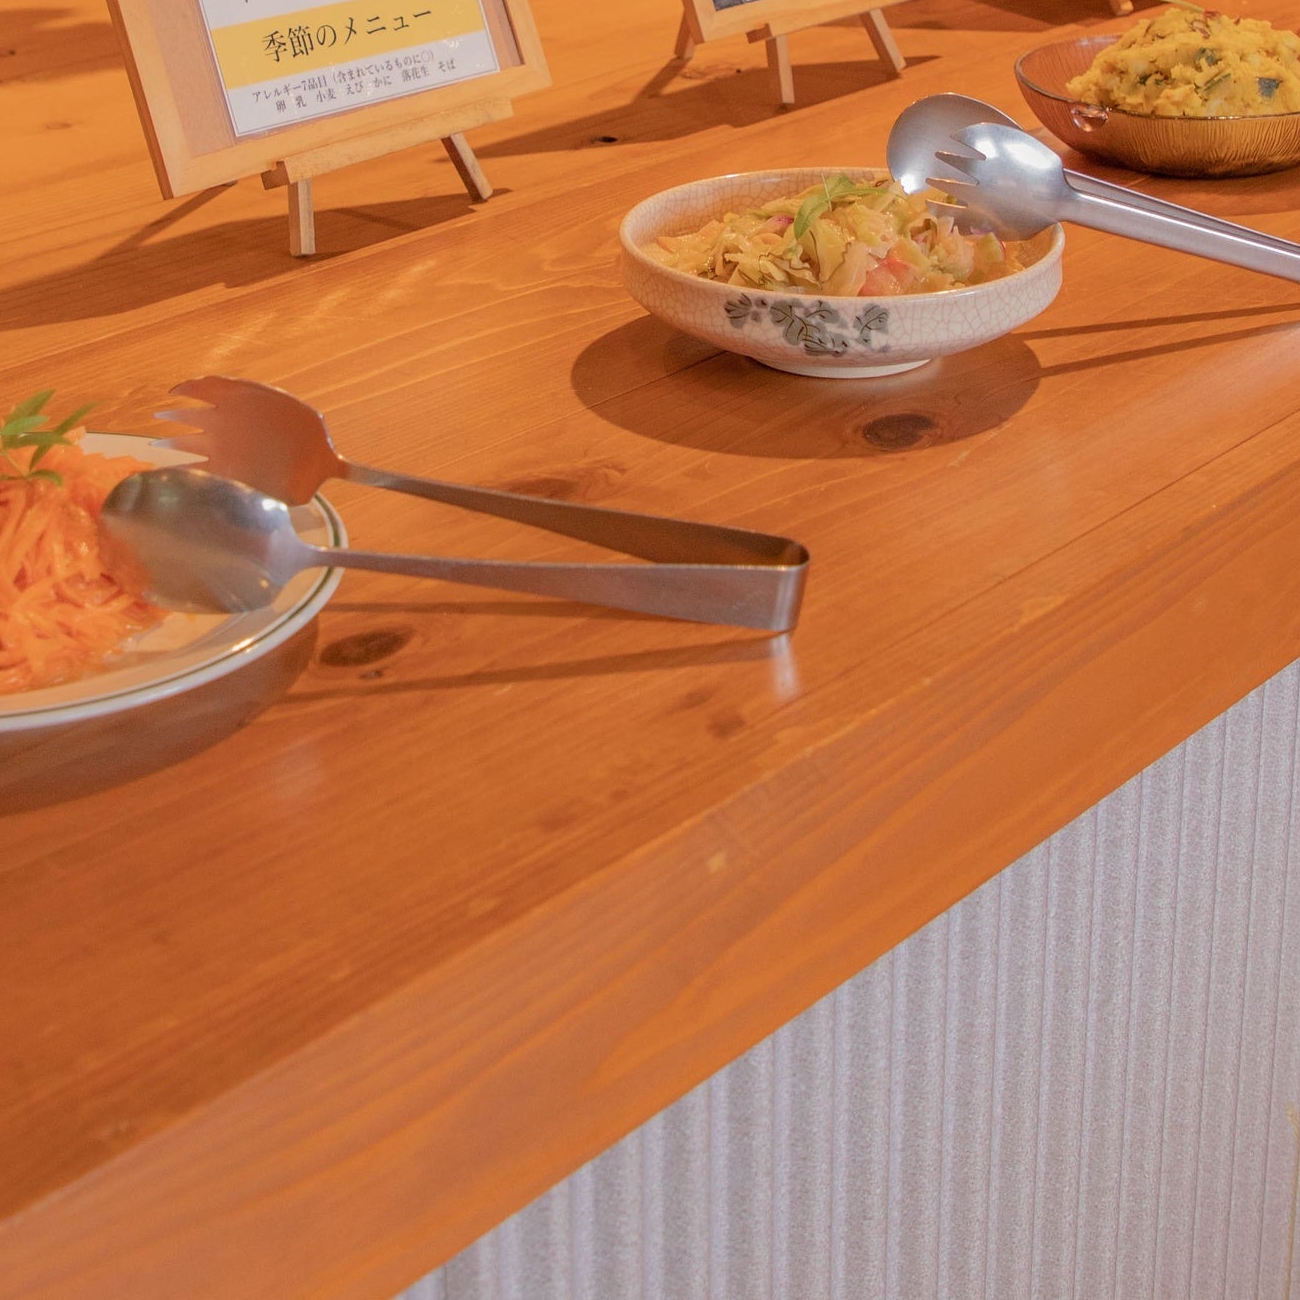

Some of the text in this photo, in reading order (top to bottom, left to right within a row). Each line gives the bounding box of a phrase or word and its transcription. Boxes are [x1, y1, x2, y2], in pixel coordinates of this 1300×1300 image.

[260, 5, 434, 64] 季節のメニュー
[315, 89, 337, 103] 小麦
[346, 82, 364, 96] えび
[373, 75, 392, 88] かに
[402, 66, 430, 83] 落花生
[438, 57, 456, 71] そば
